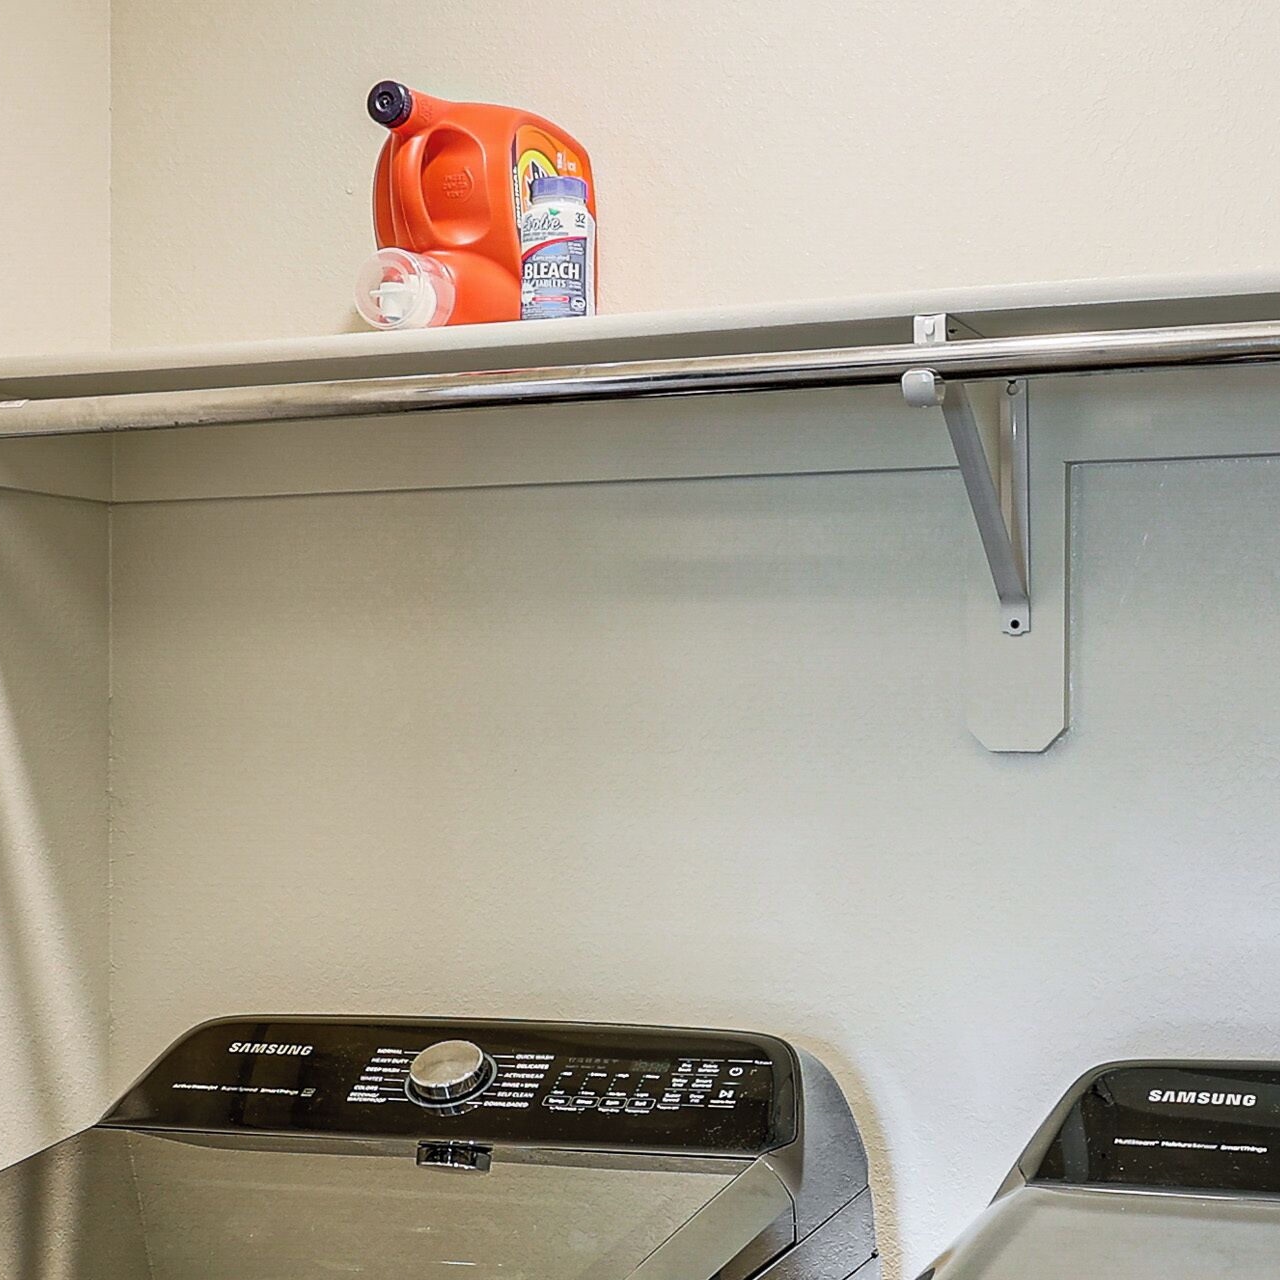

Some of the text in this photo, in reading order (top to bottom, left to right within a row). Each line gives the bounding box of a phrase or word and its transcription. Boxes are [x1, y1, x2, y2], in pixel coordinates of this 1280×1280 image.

[524, 262, 580, 279] BLEACH
[228, 1042, 313, 1056] SAMSUNG
[1148, 1090, 1256, 1106] SAMSUNG
